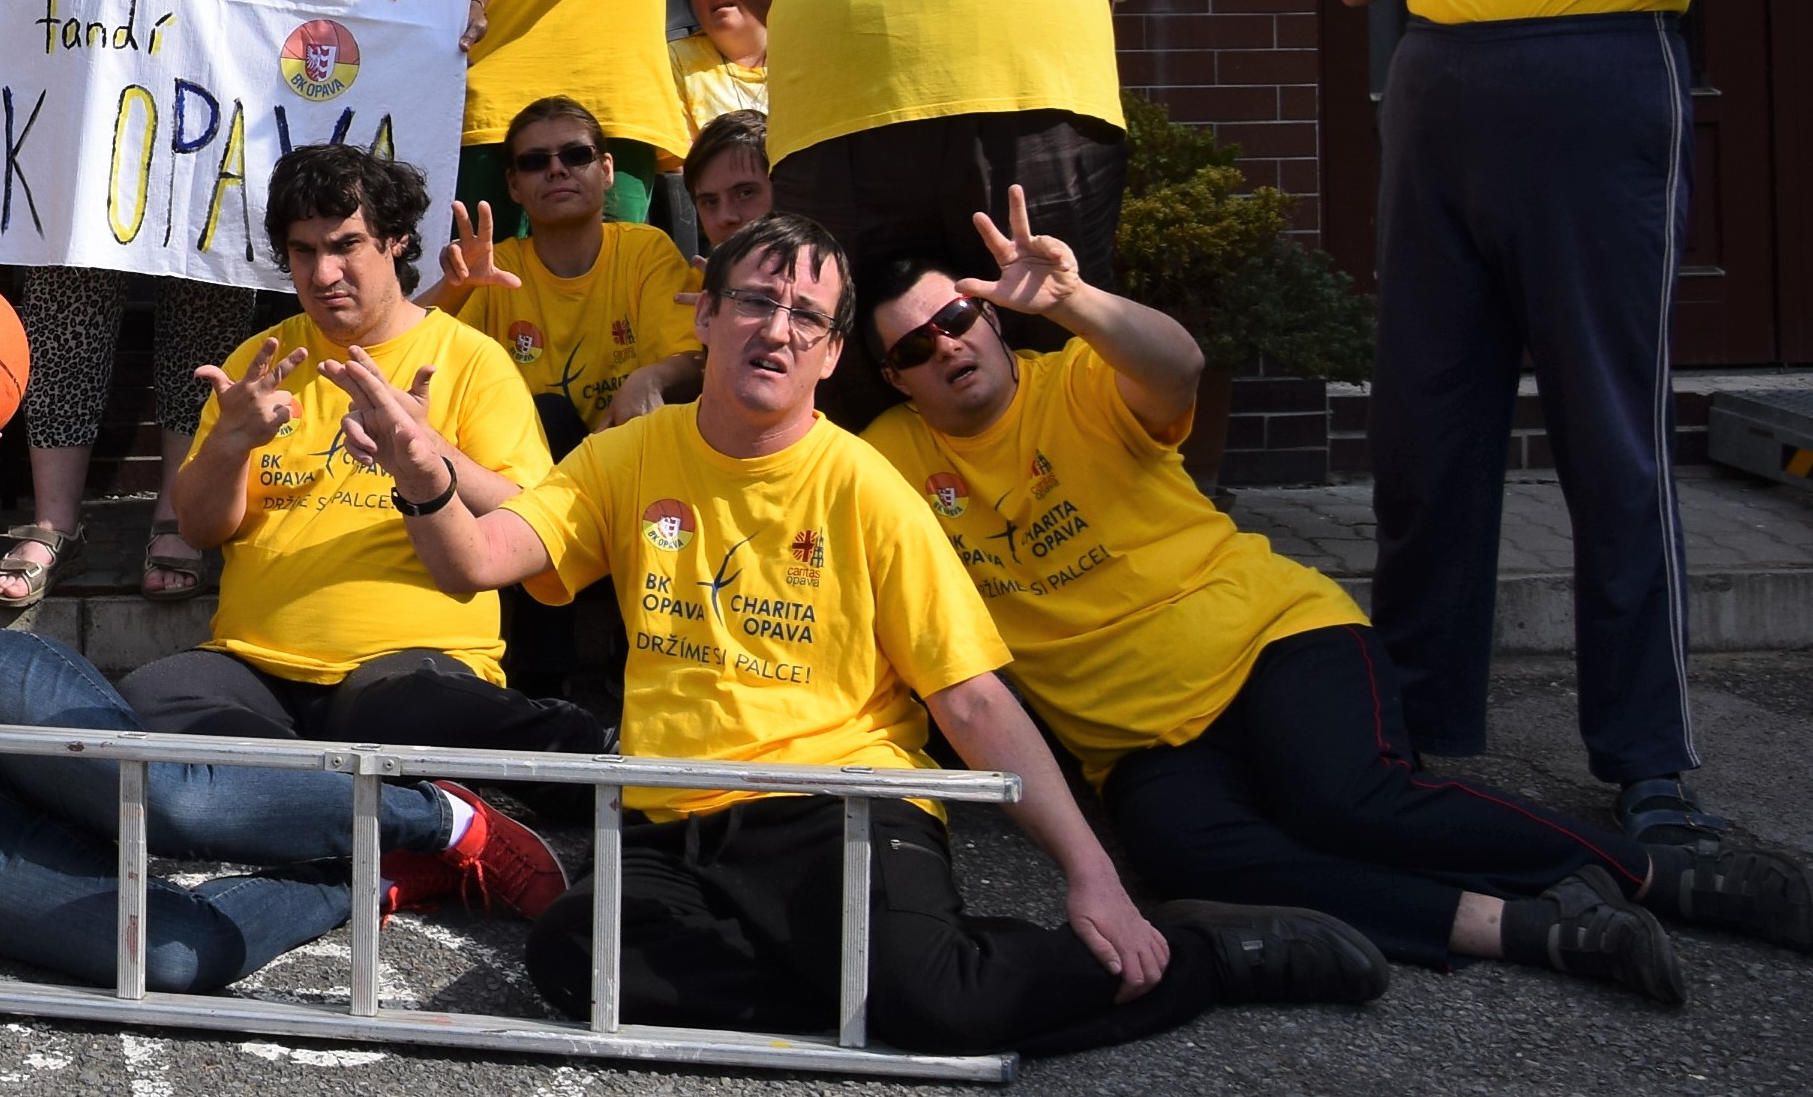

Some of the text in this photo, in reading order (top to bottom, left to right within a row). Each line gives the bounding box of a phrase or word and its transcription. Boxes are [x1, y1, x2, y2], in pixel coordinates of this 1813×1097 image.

[291, 73, 345, 98] BK OPAVA
[280, 425, 293, 436] AVA
[260, 454, 283, 469] BK
[260, 470, 315, 486] OPAVA
[331, 491, 395, 510] PALCE
[647, 530, 684, 549] BK OPAVA
[1032, 516, 1089, 558] OPAVA
[787, 567, 821, 579] caritas
[1030, 575, 1049, 596] SI
[1047, 544, 1111, 590] PALCE!
[645, 573, 672, 594] BK
[786, 576, 820, 588] opava
[642, 593, 705, 622] OPAVA
[730, 594, 816, 623] CHARITA
[743, 617, 814, 644] OPAVA
[637, 632, 811, 684] DRŽÍME SI PALCE!
